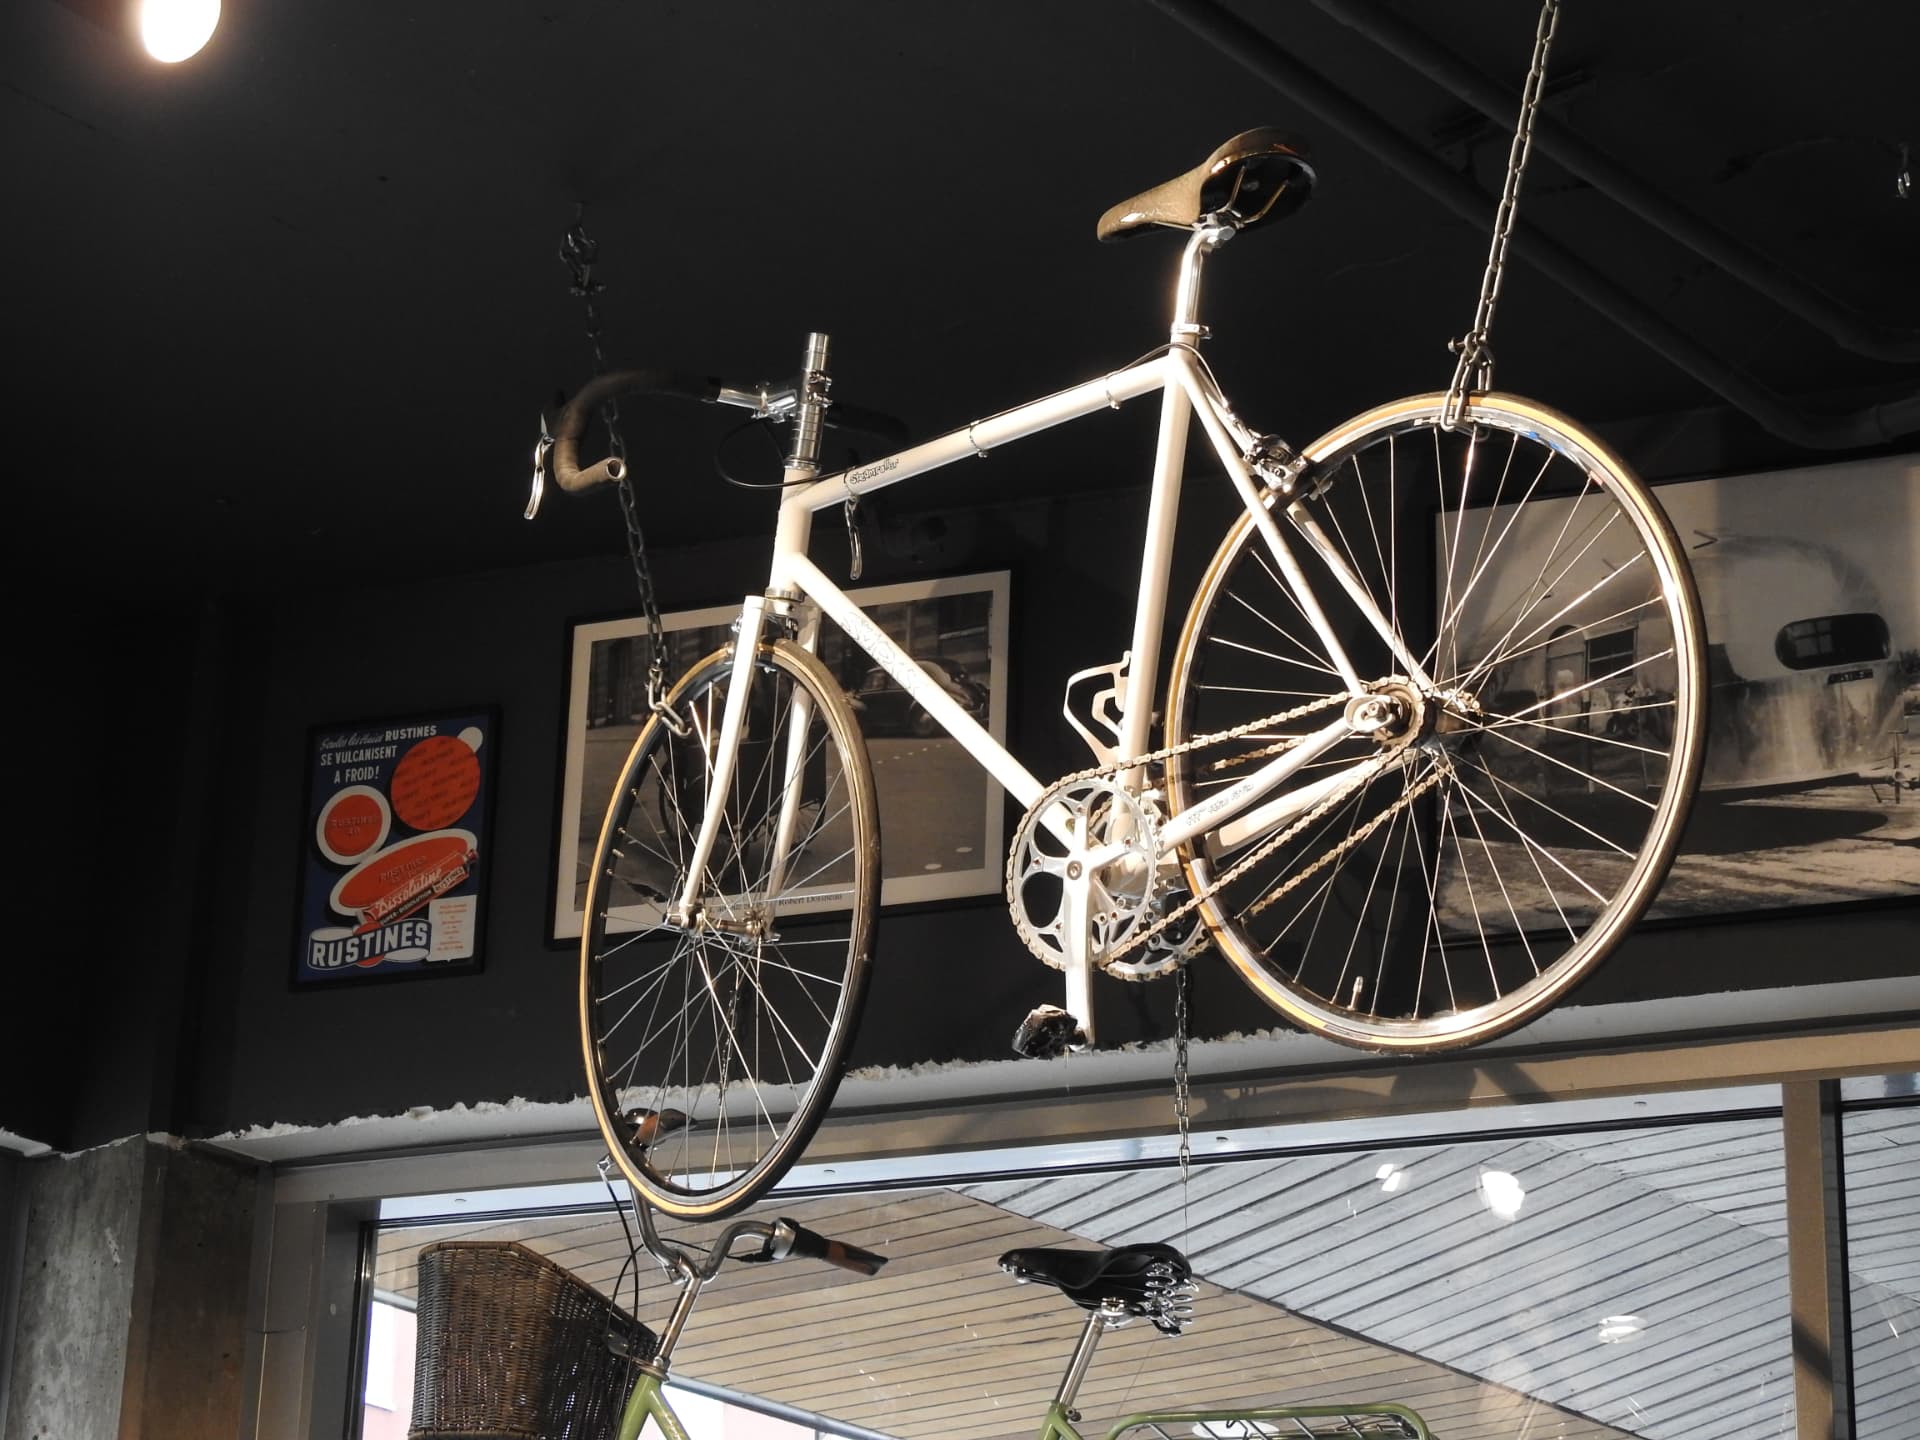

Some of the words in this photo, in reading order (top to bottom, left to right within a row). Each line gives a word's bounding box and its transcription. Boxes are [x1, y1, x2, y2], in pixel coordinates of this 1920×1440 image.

[384, 725, 437, 742] RUSTINES
[320, 753, 333, 766] SE
[335, 745, 398, 765] VULCANISENT
[345, 765, 380, 783] FROID!
[311, 921, 429, 968] RUSTINES
